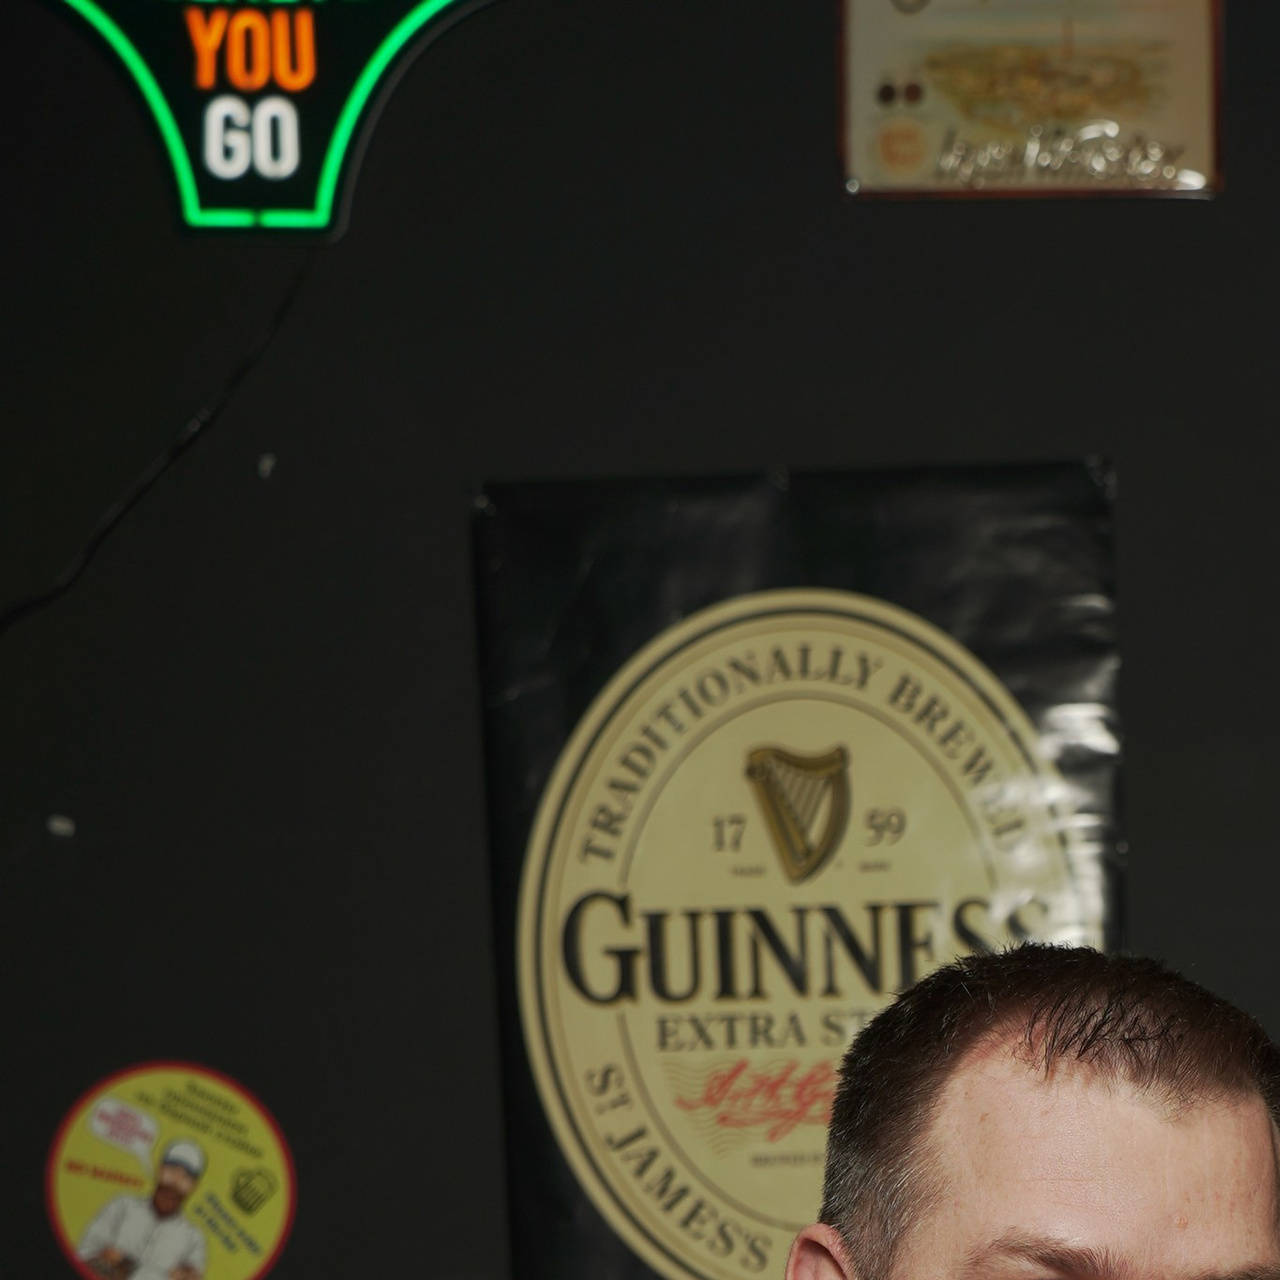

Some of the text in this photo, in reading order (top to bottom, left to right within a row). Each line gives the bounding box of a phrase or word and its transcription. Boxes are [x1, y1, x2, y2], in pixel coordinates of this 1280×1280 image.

[185, 7, 317, 91] YOU
[204, 95, 299, 180] GO
[579, 643, 1026, 865] TRADITIONALLY BREWD
[712, 806, 907, 852] 17 59
[656, 1011, 809, 1052] EXTRA
[605, 1122, 774, 1274] JAMES'S
